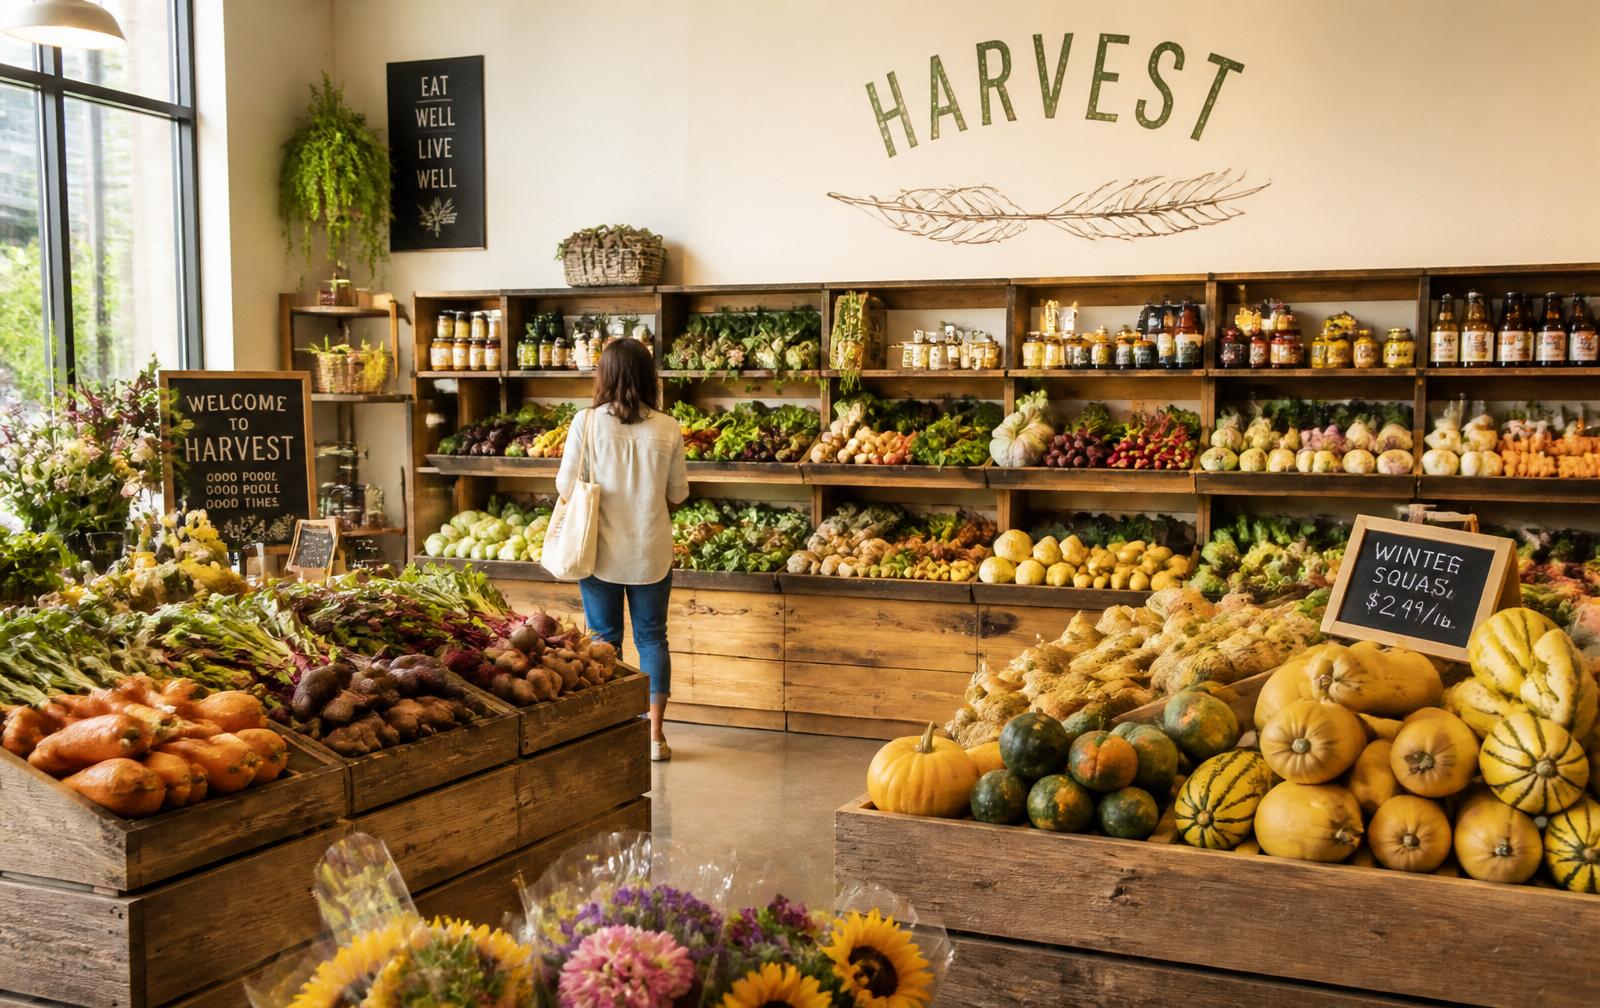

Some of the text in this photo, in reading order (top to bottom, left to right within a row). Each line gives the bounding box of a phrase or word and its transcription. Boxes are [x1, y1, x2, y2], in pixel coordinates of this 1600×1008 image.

[421, 75, 449, 97] EAT
[865, 32, 1245, 158] HARVEST
[415, 106, 456, 128] WELL
[418, 137, 453, 160] LIVE
[416, 167, 457, 189] WELL
[185, 393, 287, 412] WELCOME
[228, 417, 249, 431] TO
[184, 435, 294, 463] HARVEST
